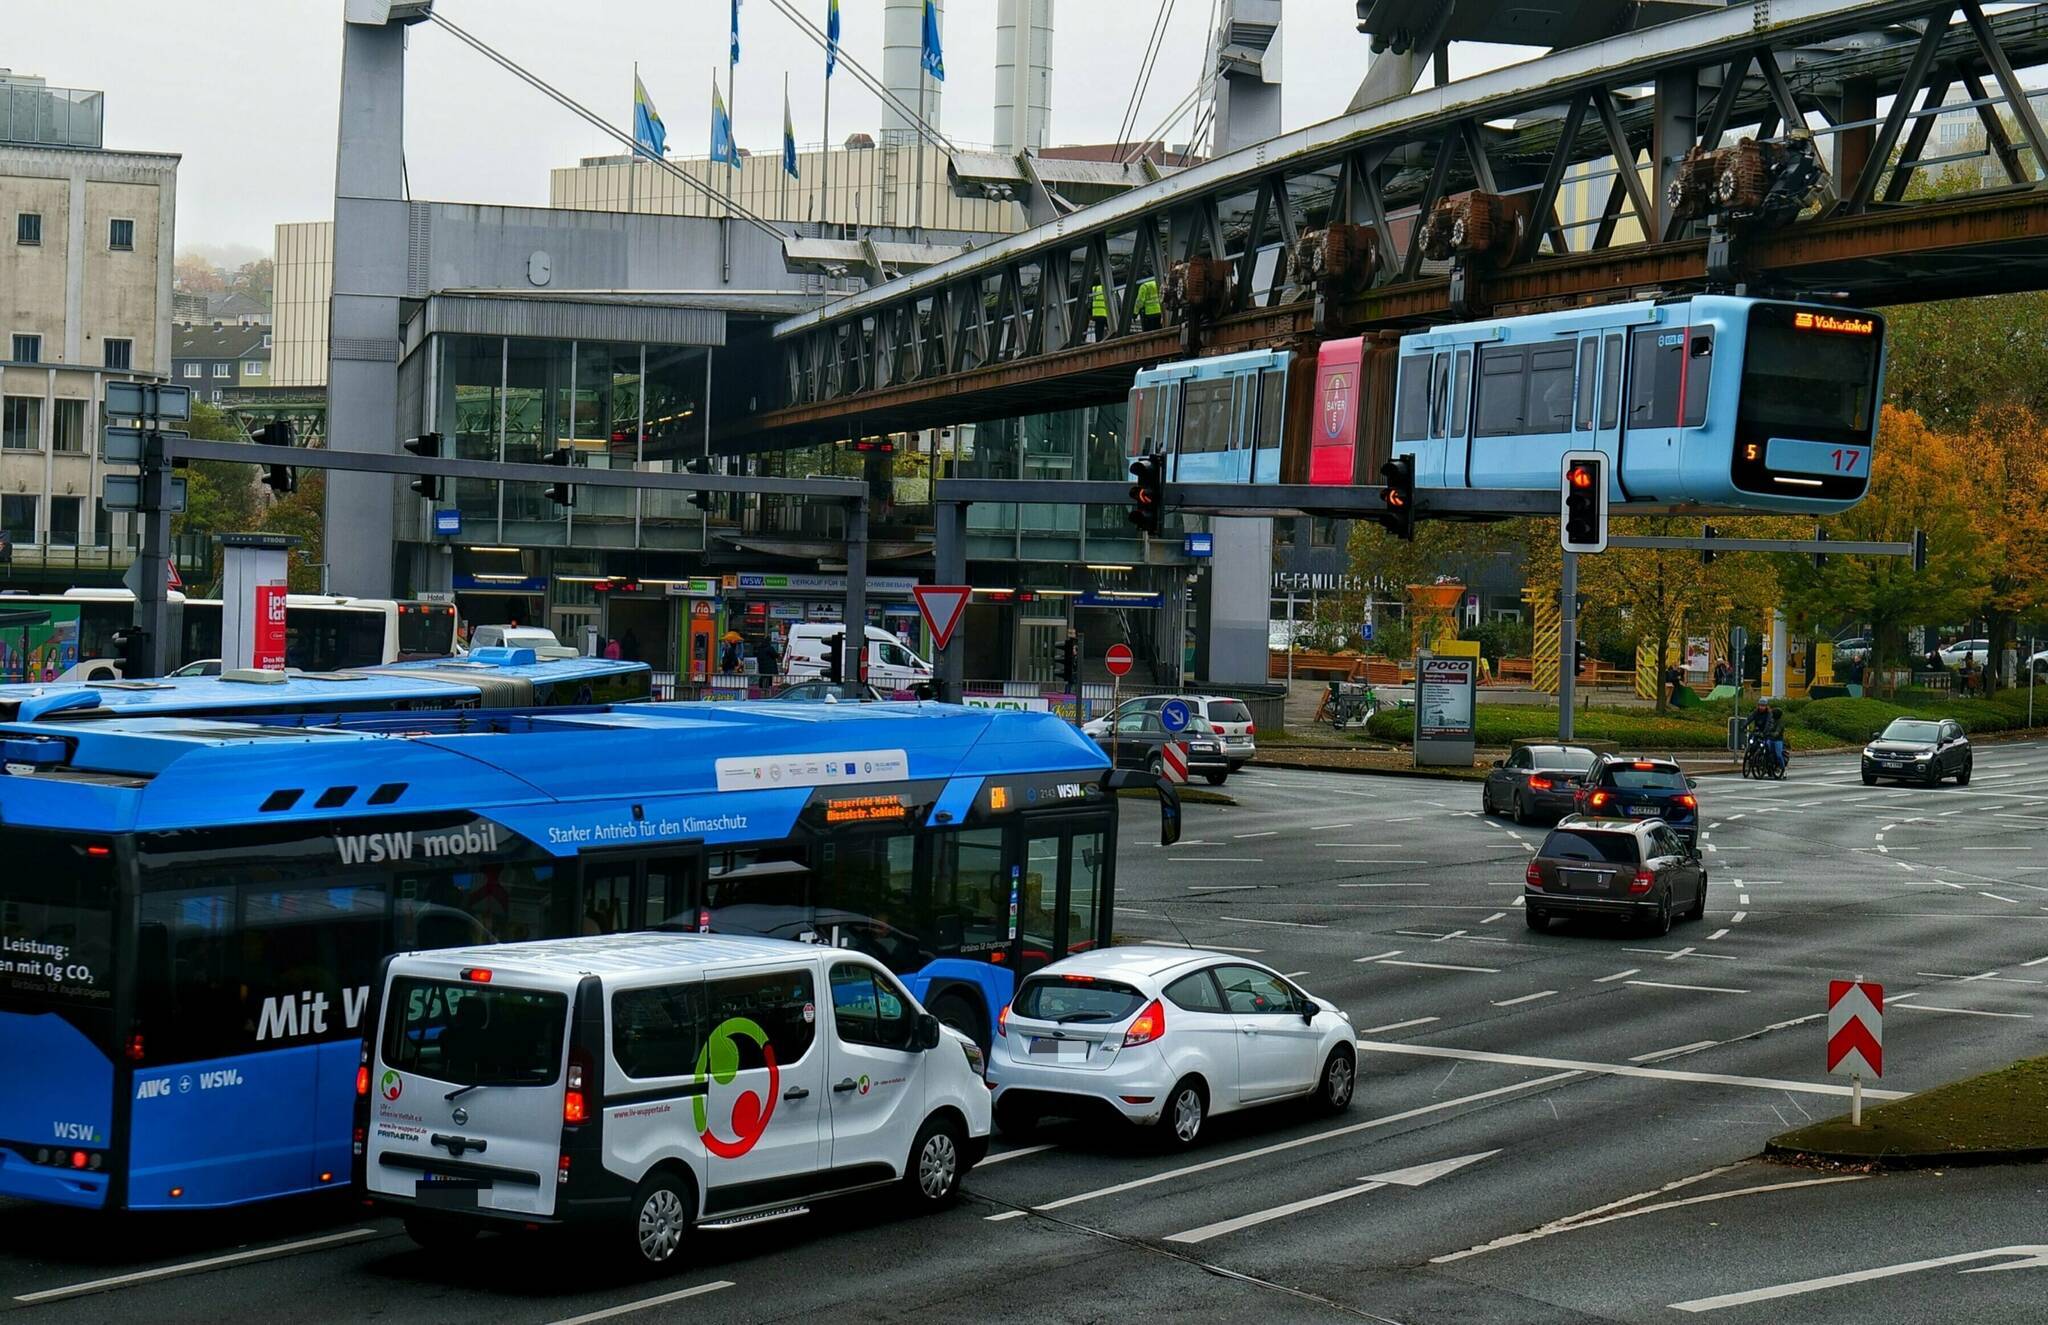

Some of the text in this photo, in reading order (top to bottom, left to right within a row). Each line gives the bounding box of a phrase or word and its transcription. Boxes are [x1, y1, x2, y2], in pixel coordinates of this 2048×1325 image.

[1815, 315, 1873, 333] Vohwinkel
[1327, 400, 1345, 411] BAYER
[1747, 444, 1757, 460] 5
[1831, 449, 1860, 472] 17
[866, 580, 913, 589] CHWEBEBAHN
[1426, 661, 1470, 671] POCO
[548, 813, 748, 844] Starker Antrieb für den Klimaschutz
[336, 823, 498, 865] WSW mobil
[3, 936, 70, 961] Leistung:
[17, 960, 42, 976] mit
[44, 962, 64, 982] 0g
[256, 990, 330, 1041] Mit
[136, 1078, 171, 1100] AWG
[377, 1129, 419, 1142] PRIMASTAR
